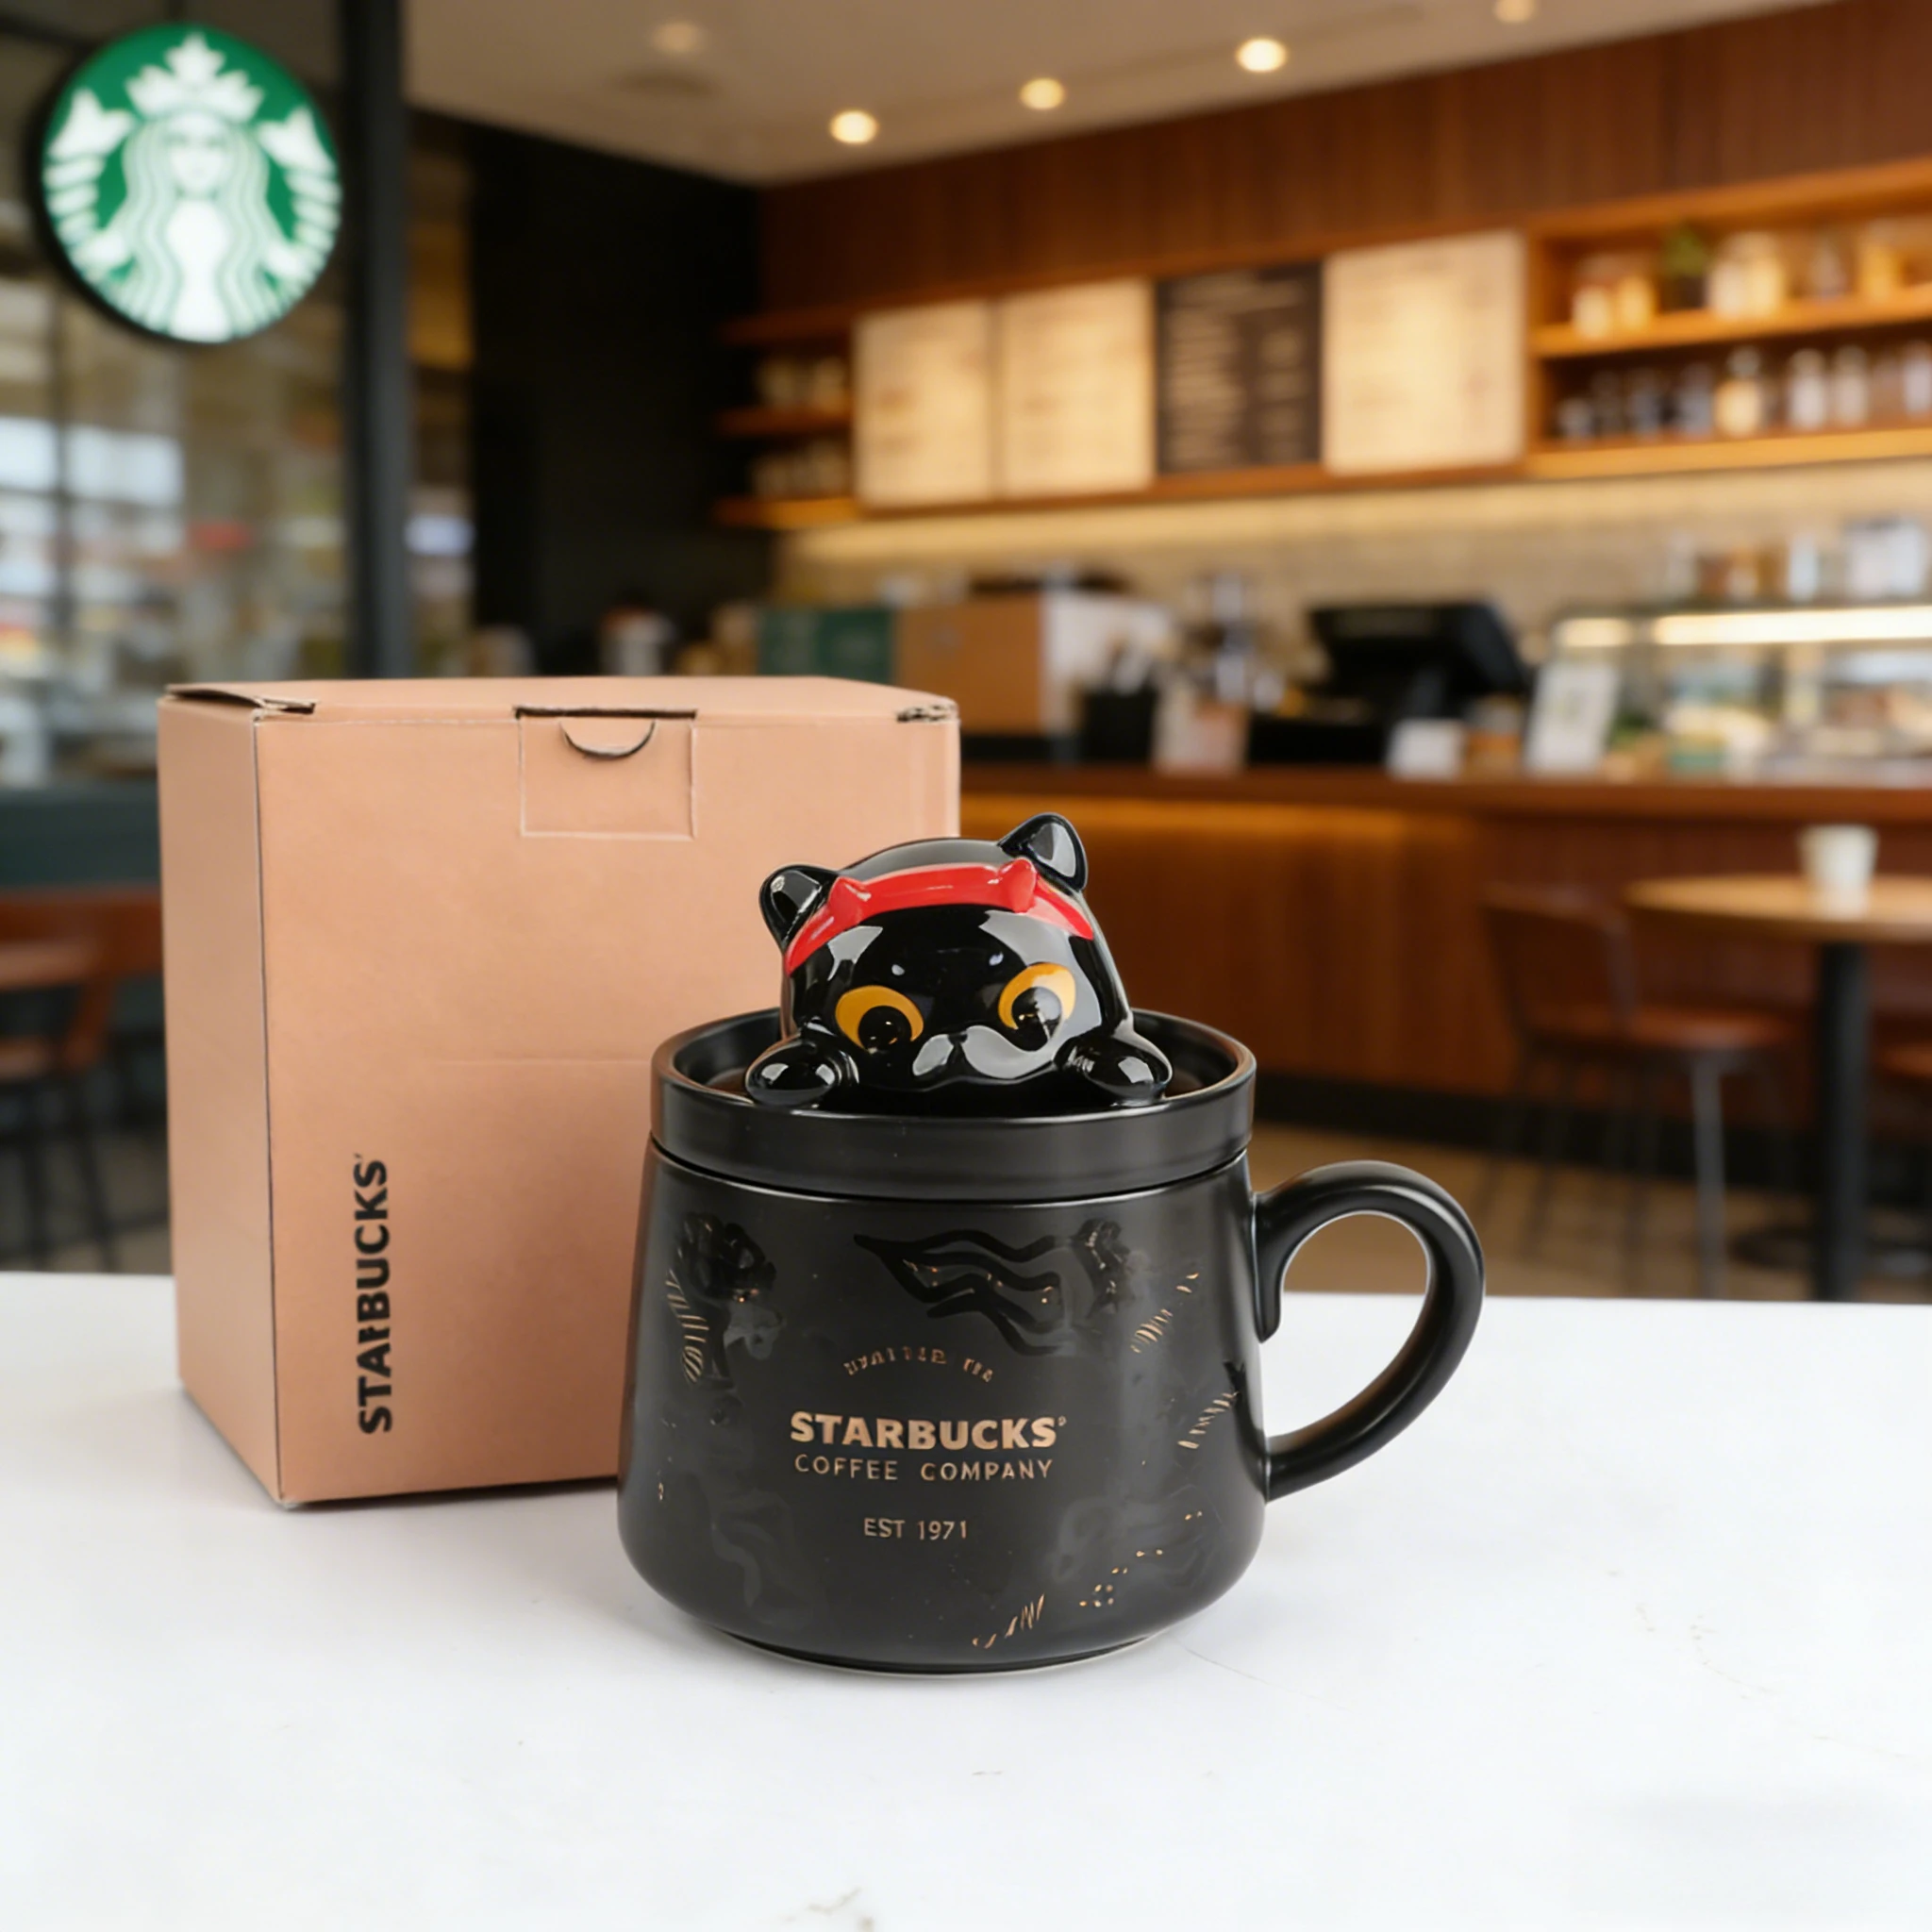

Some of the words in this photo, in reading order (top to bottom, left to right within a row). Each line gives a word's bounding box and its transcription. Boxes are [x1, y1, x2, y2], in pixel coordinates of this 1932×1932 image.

[790, 1410, 1060, 1451] STARBUCKS
[794, 1454, 898, 1480] COFFEE
[920, 1458, 1054, 1481] COMPANY
[863, 1517, 906, 1538] EST
[917, 1520, 968, 1541] 1971
